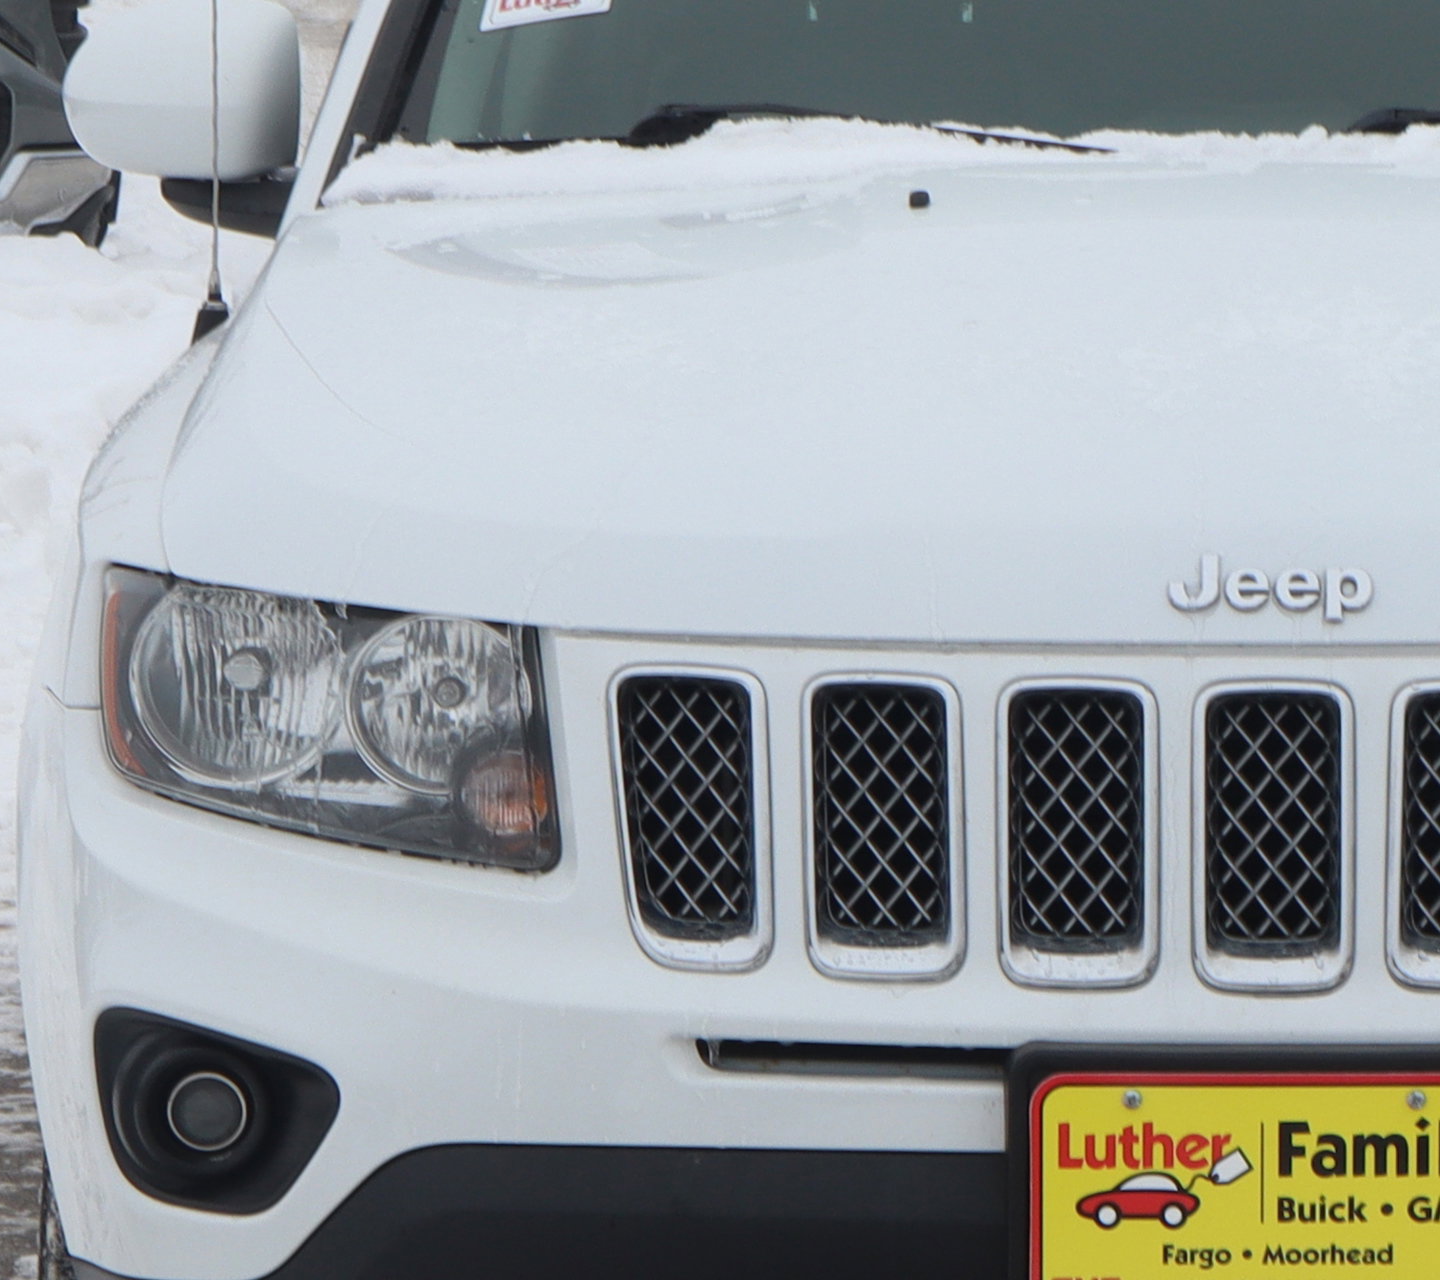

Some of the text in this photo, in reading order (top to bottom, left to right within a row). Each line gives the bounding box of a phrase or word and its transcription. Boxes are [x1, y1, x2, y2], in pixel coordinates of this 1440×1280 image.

[1166, 552, 1375, 624] Jeep
[1058, 1122, 1232, 1170] Luther
[1277, 1195, 1368, 1223] Buick
[1162, 1243, 1394, 1270] Fargo Moorhead
